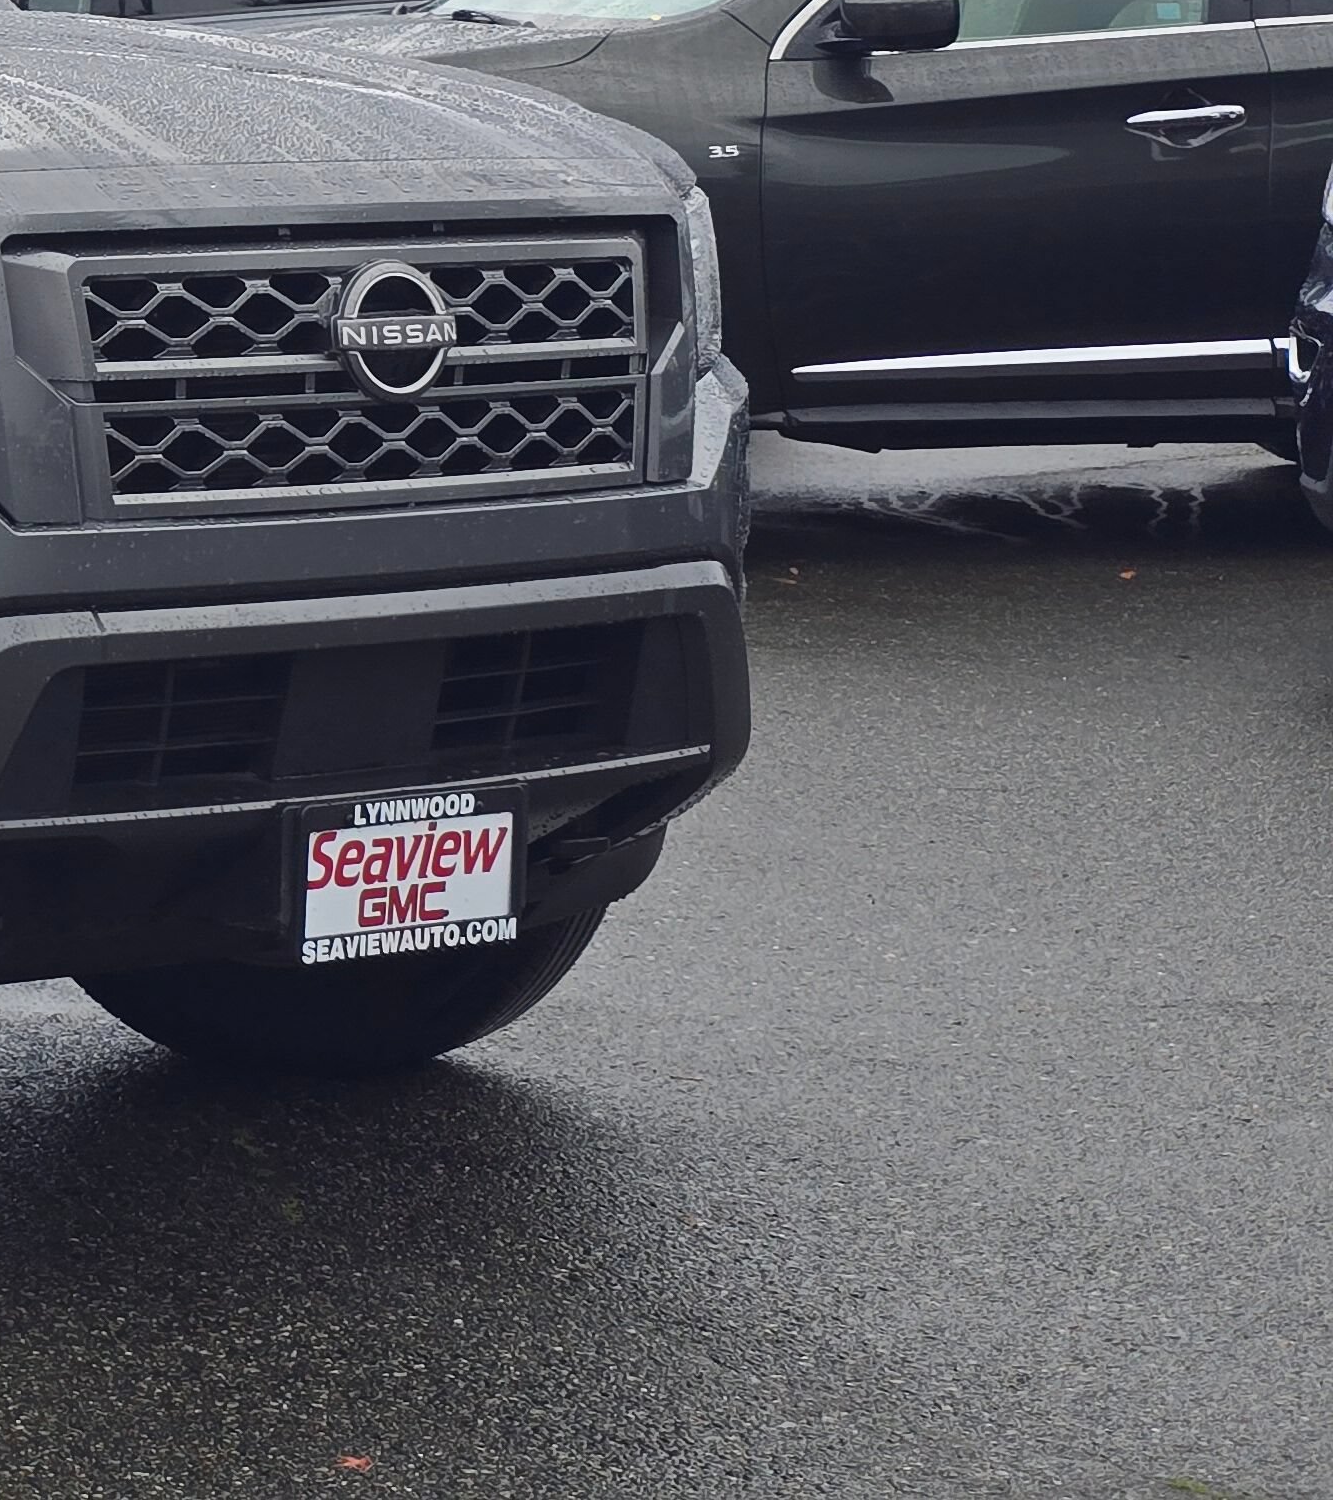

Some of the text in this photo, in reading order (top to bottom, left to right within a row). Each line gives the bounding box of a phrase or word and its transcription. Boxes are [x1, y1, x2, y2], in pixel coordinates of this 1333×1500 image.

[341, 322, 457, 346] NISSAN
[353, 793, 475, 826] LYNNWOOD
[306, 822, 508, 890] Seaview
[357, 880, 449, 928] GMC
[301, 917, 517, 965] SEAVIEWAUTO.COM
